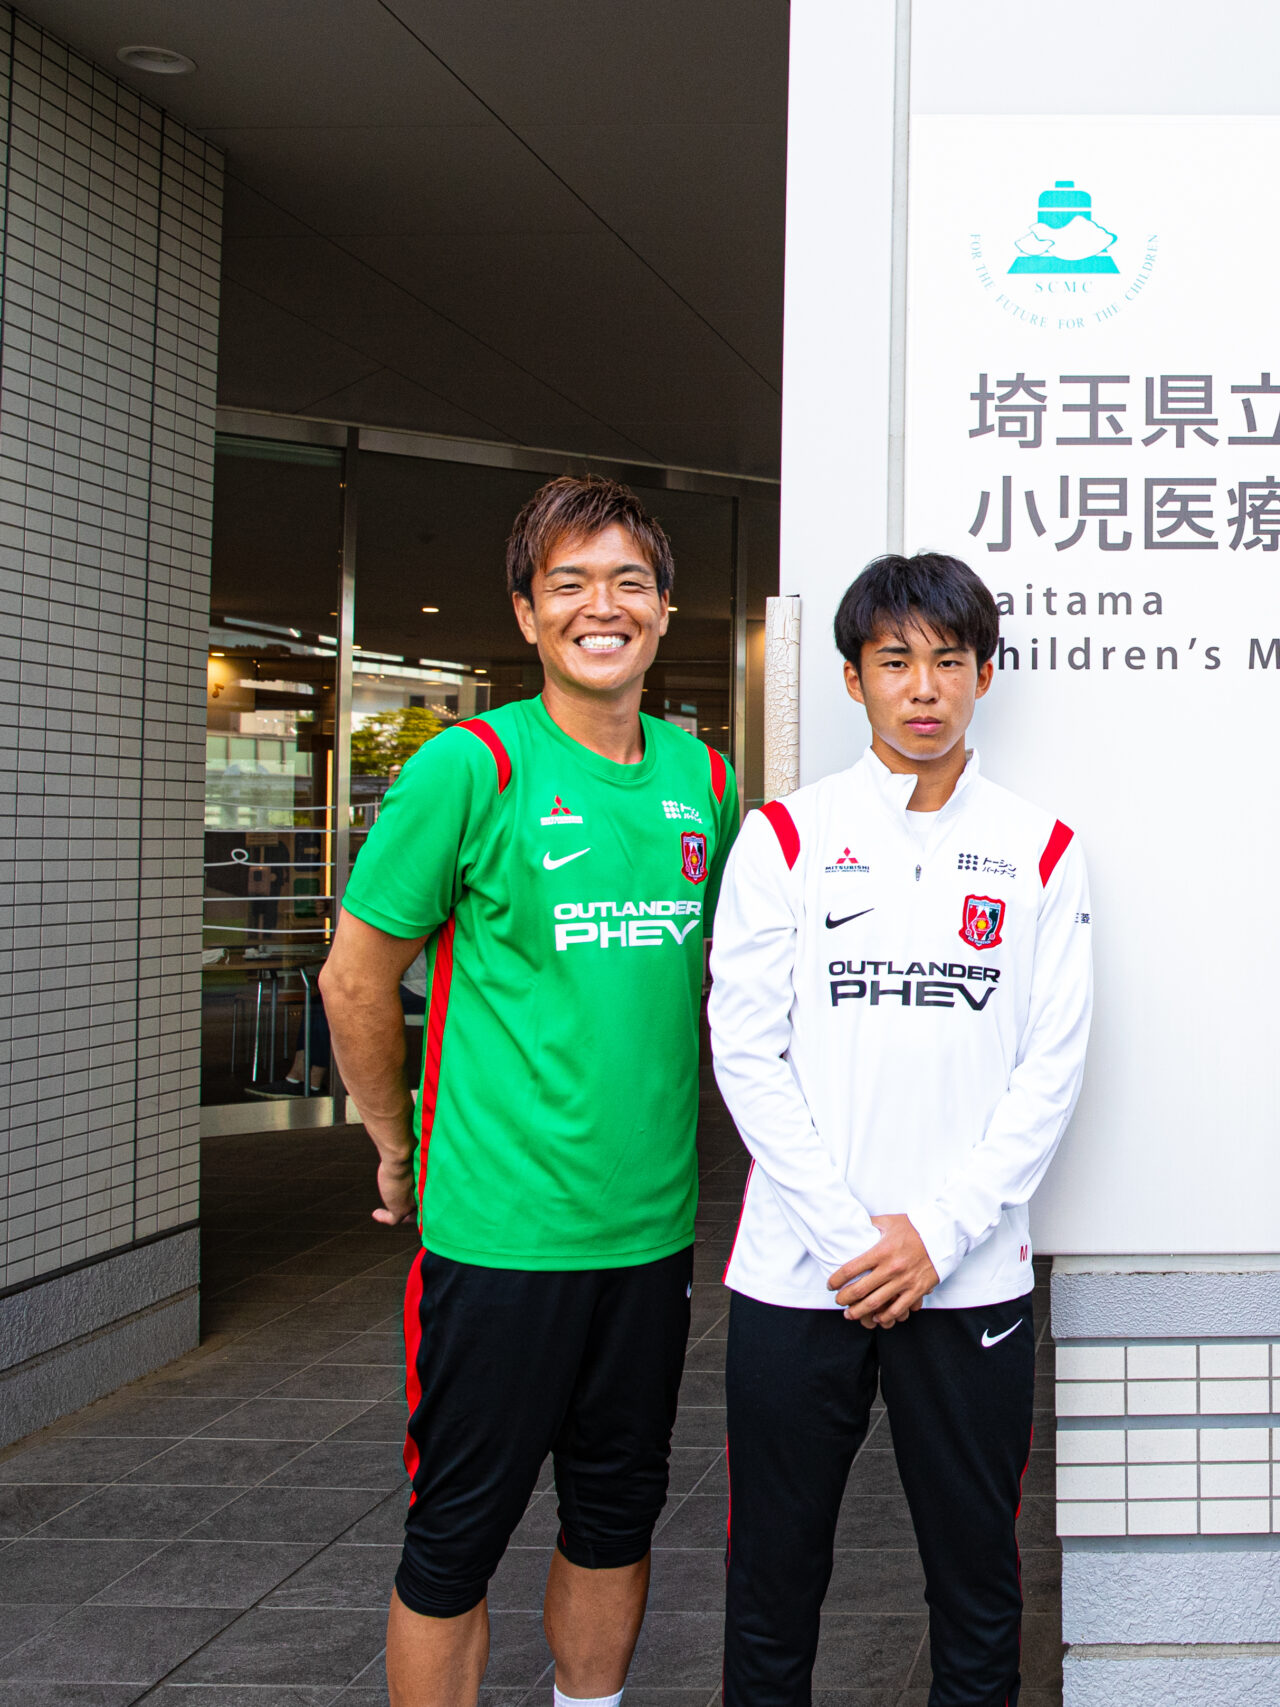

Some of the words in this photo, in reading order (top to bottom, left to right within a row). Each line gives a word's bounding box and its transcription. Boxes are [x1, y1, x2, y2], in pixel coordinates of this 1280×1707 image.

[970, 233, 982, 260] FOR
[975, 264, 995, 291] THE
[1124, 233, 1160, 301] CHILDREN
[1034, 281, 1092, 293] SCMC
[995, 294, 1048, 328] FUTURE
[1058, 317, 1085, 329] FOR
[1095, 304, 1121, 323] THE
[997, 584, 1163, 616] aitama
[998, 636, 1221, 670] hildren’s
[554, 901, 701, 920] OUTLANDER
[555, 919, 700, 951] PHEV
[828, 960, 1001, 983] OUTLANDER
[830, 980, 998, 1011] PHEV
